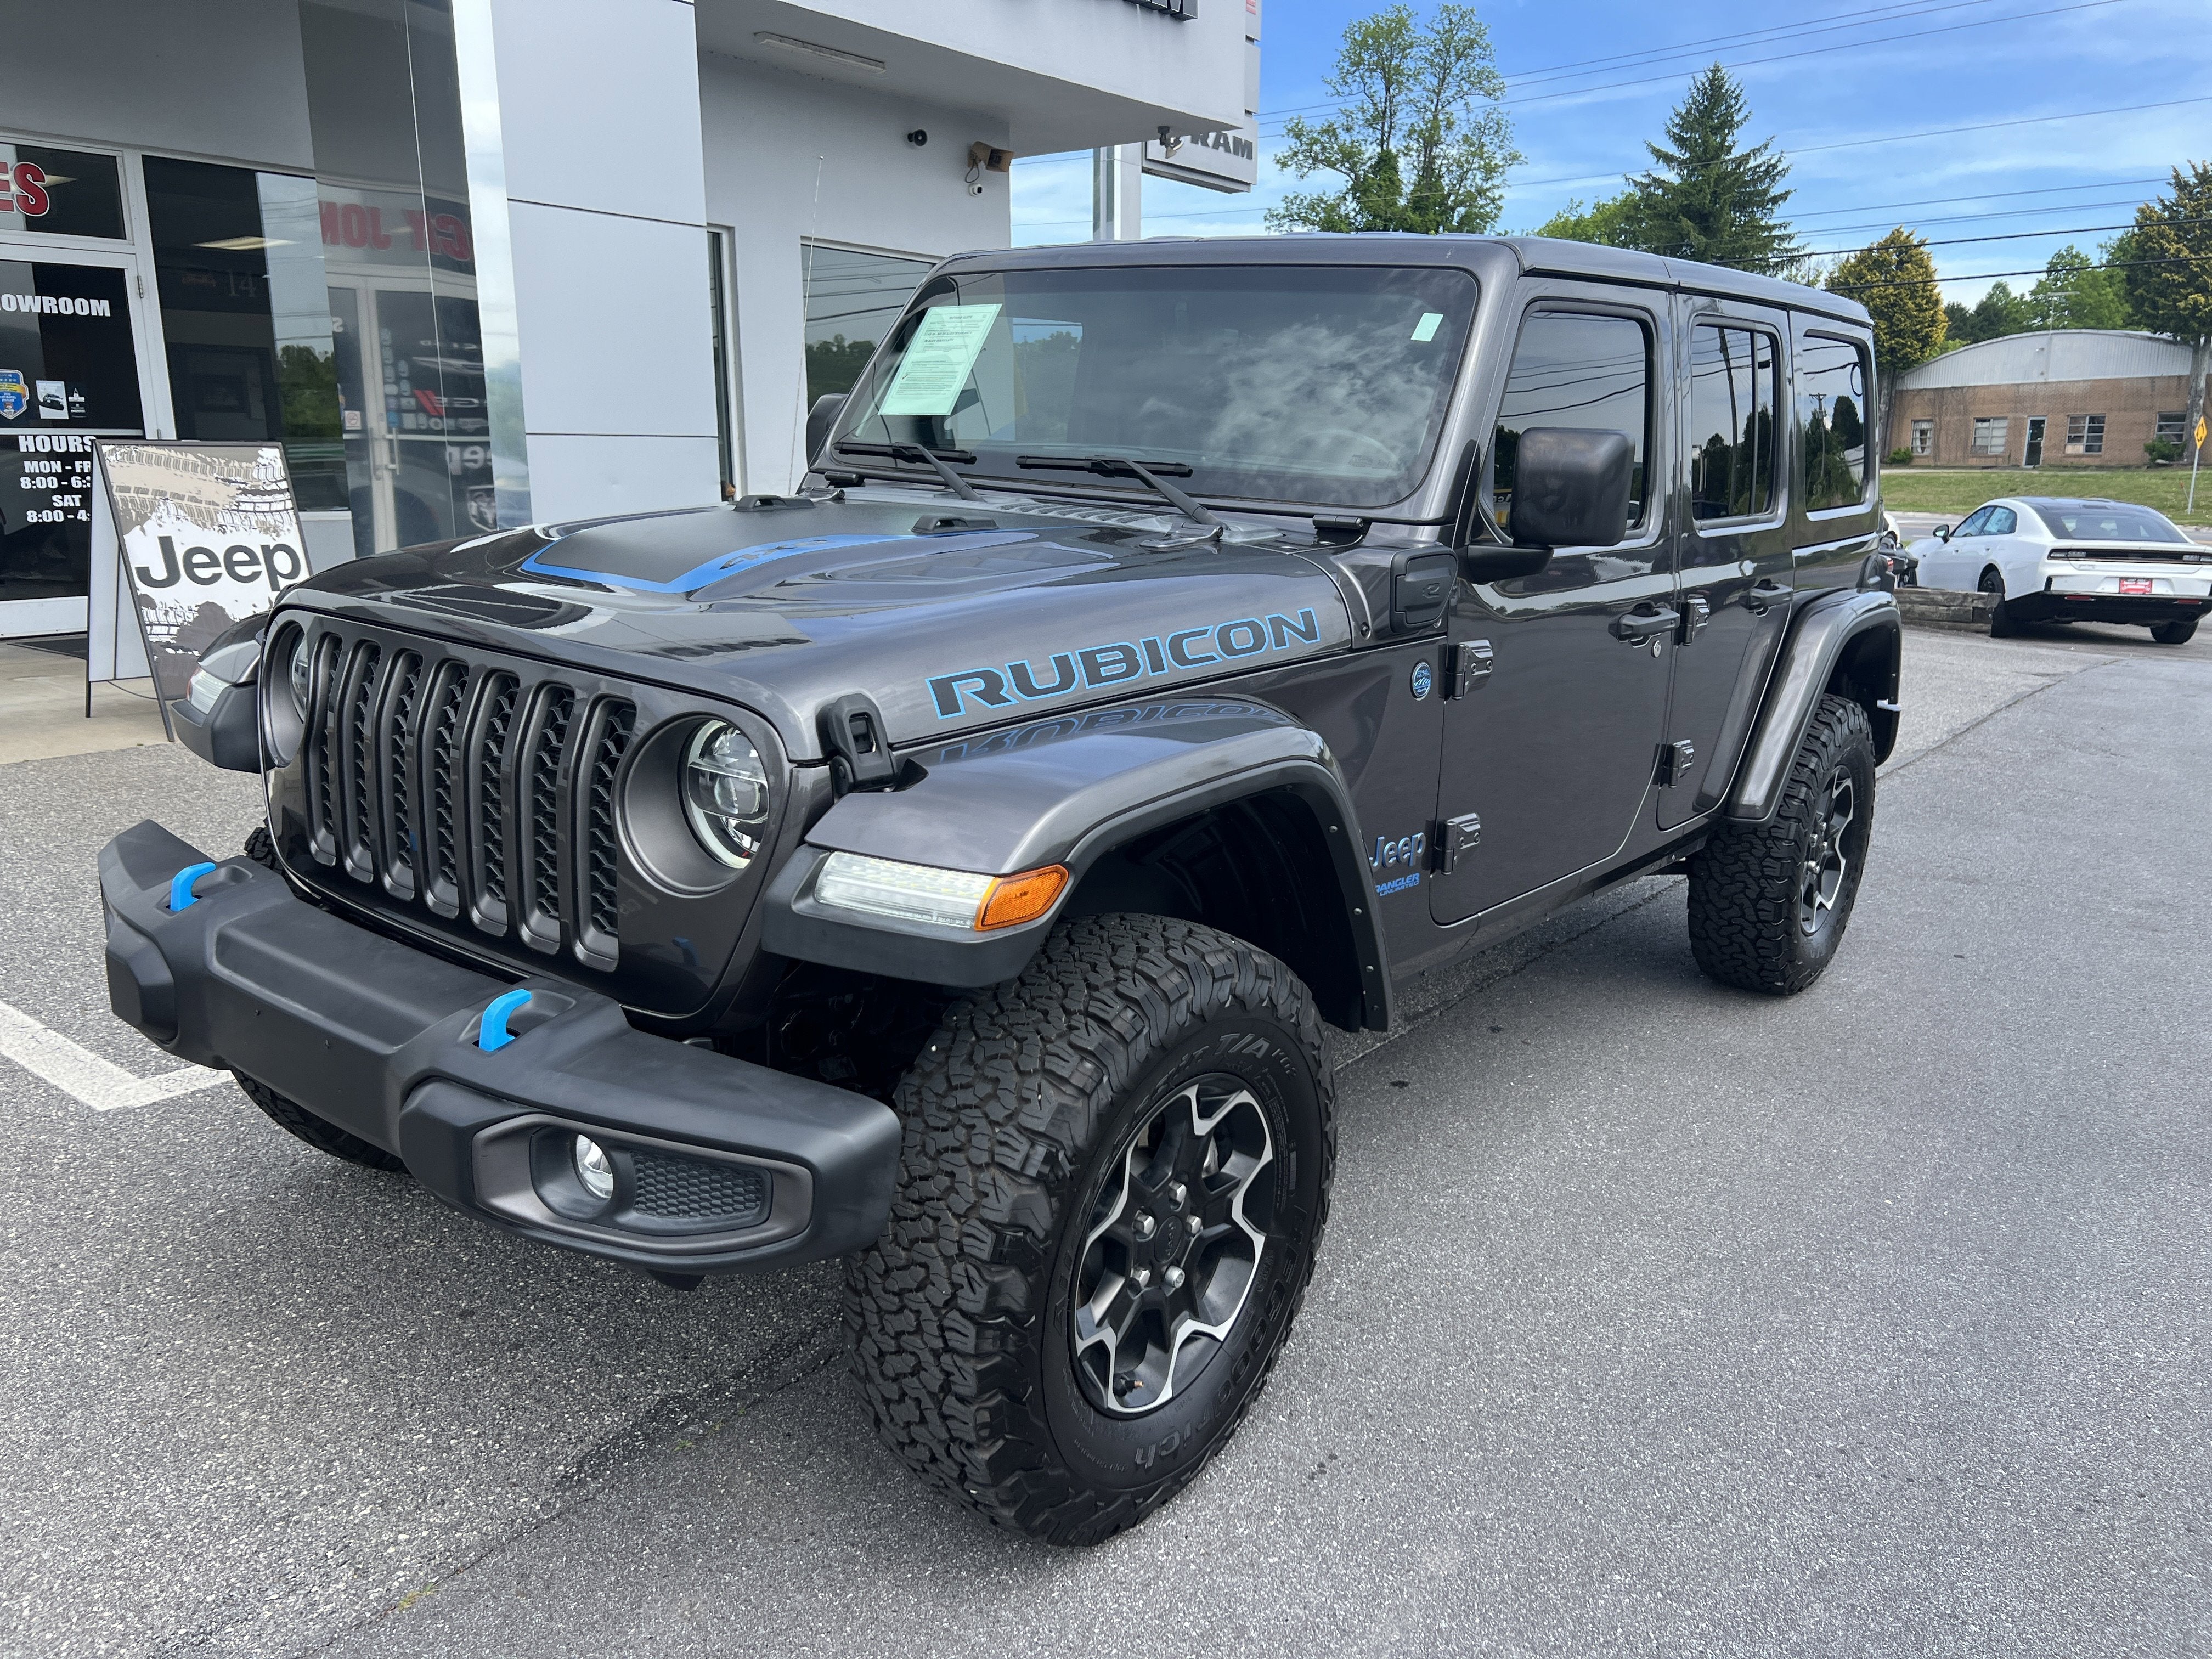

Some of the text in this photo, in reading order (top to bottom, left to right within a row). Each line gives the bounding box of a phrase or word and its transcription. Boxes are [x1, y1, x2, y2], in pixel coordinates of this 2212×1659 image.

[1190, 131, 1254, 161] RAM
[0, 294, 110, 317] OWROOM
[18, 435, 96, 452] HOURS
[24, 460, 63, 473] MON
[20, 476, 59, 489] 8:00
[52, 494, 82, 507] SAT
[26, 509, 65, 523] 8:00
[134, 535, 301, 591] Jeep
[925, 607, 1321, 720] RUBICON
[1369, 832, 1426, 873] Jeep
[1375, 872, 1420, 893] RANGLER
[1379, 881, 1420, 896] UNLIMITED
